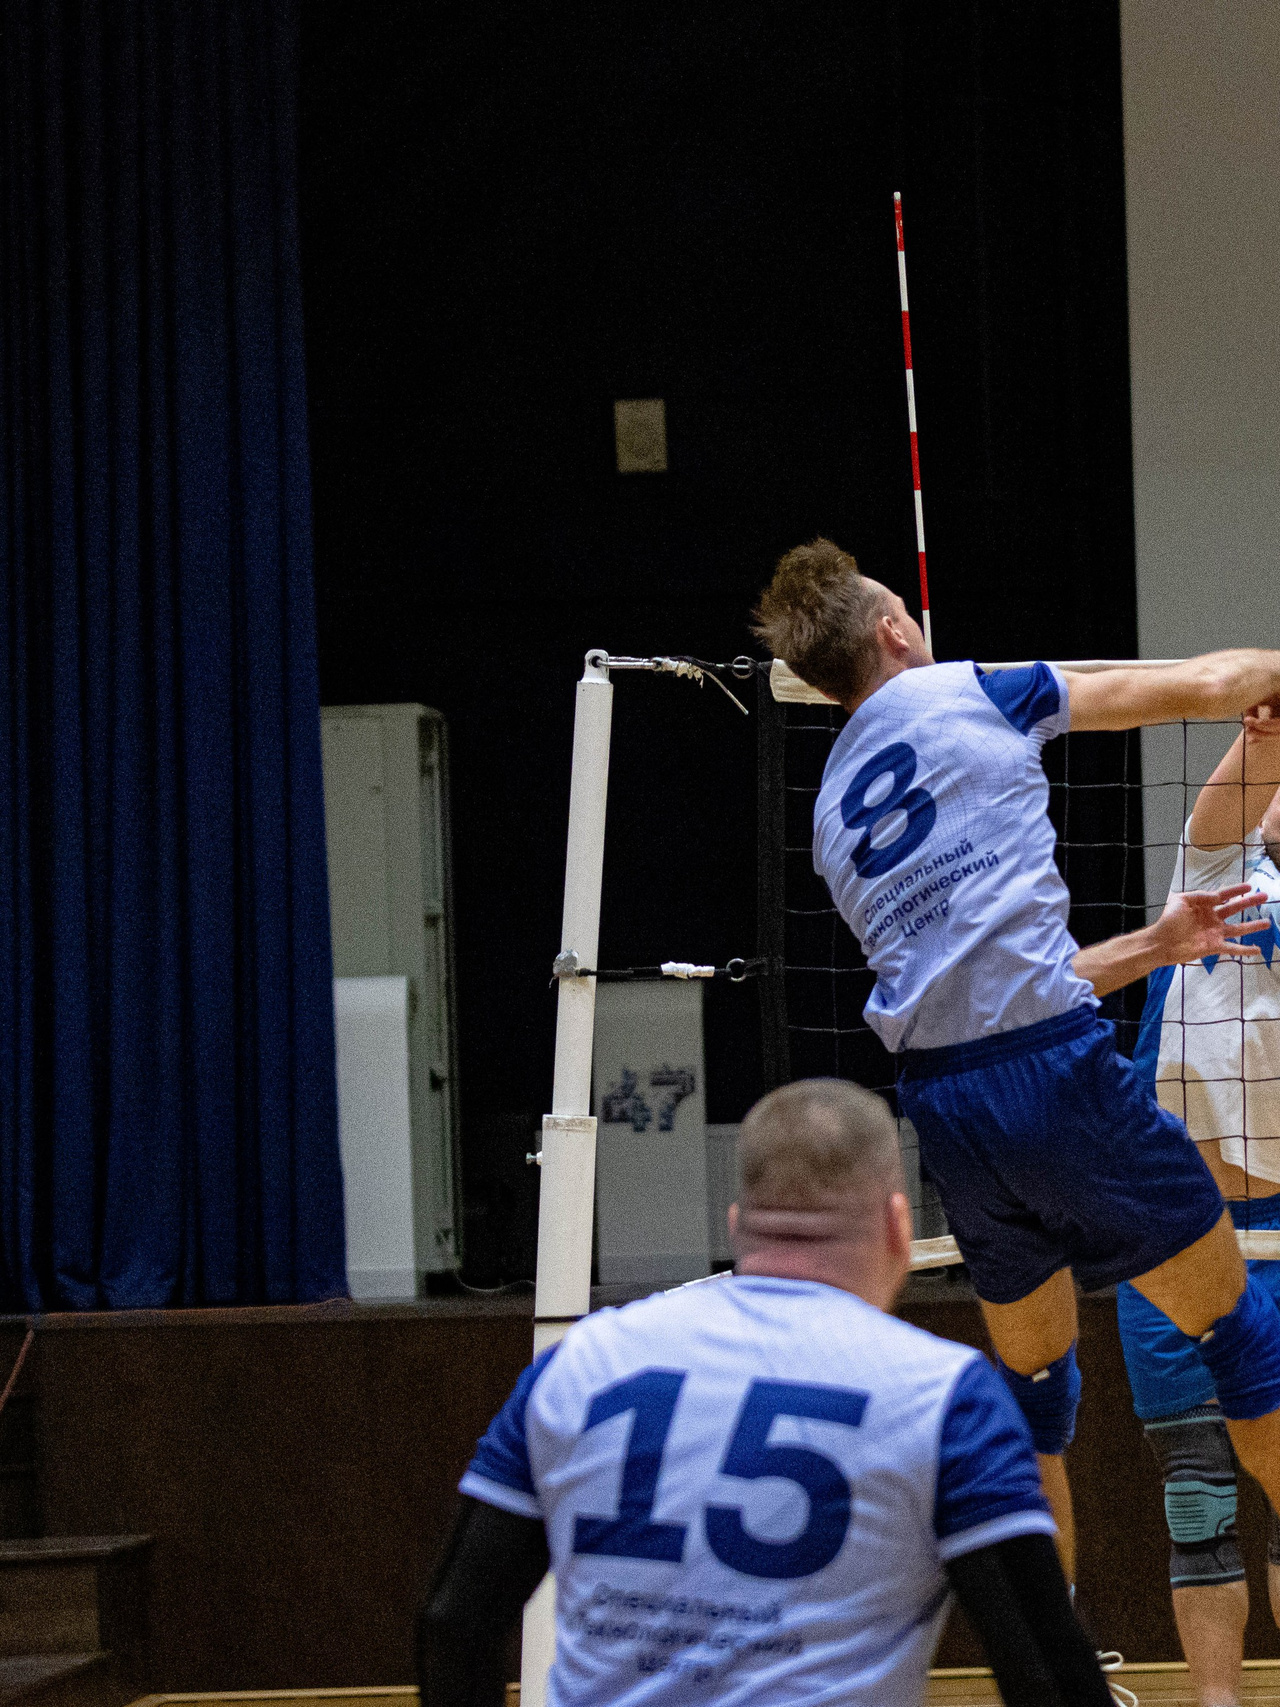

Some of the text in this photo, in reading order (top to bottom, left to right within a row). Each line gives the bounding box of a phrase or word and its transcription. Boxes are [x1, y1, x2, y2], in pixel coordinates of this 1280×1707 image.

[841, 741, 937, 879] 8
[864, 838, 974, 925] Специальный
[901, 900, 950, 938] Центр
[573, 1366, 870, 1579] 15
